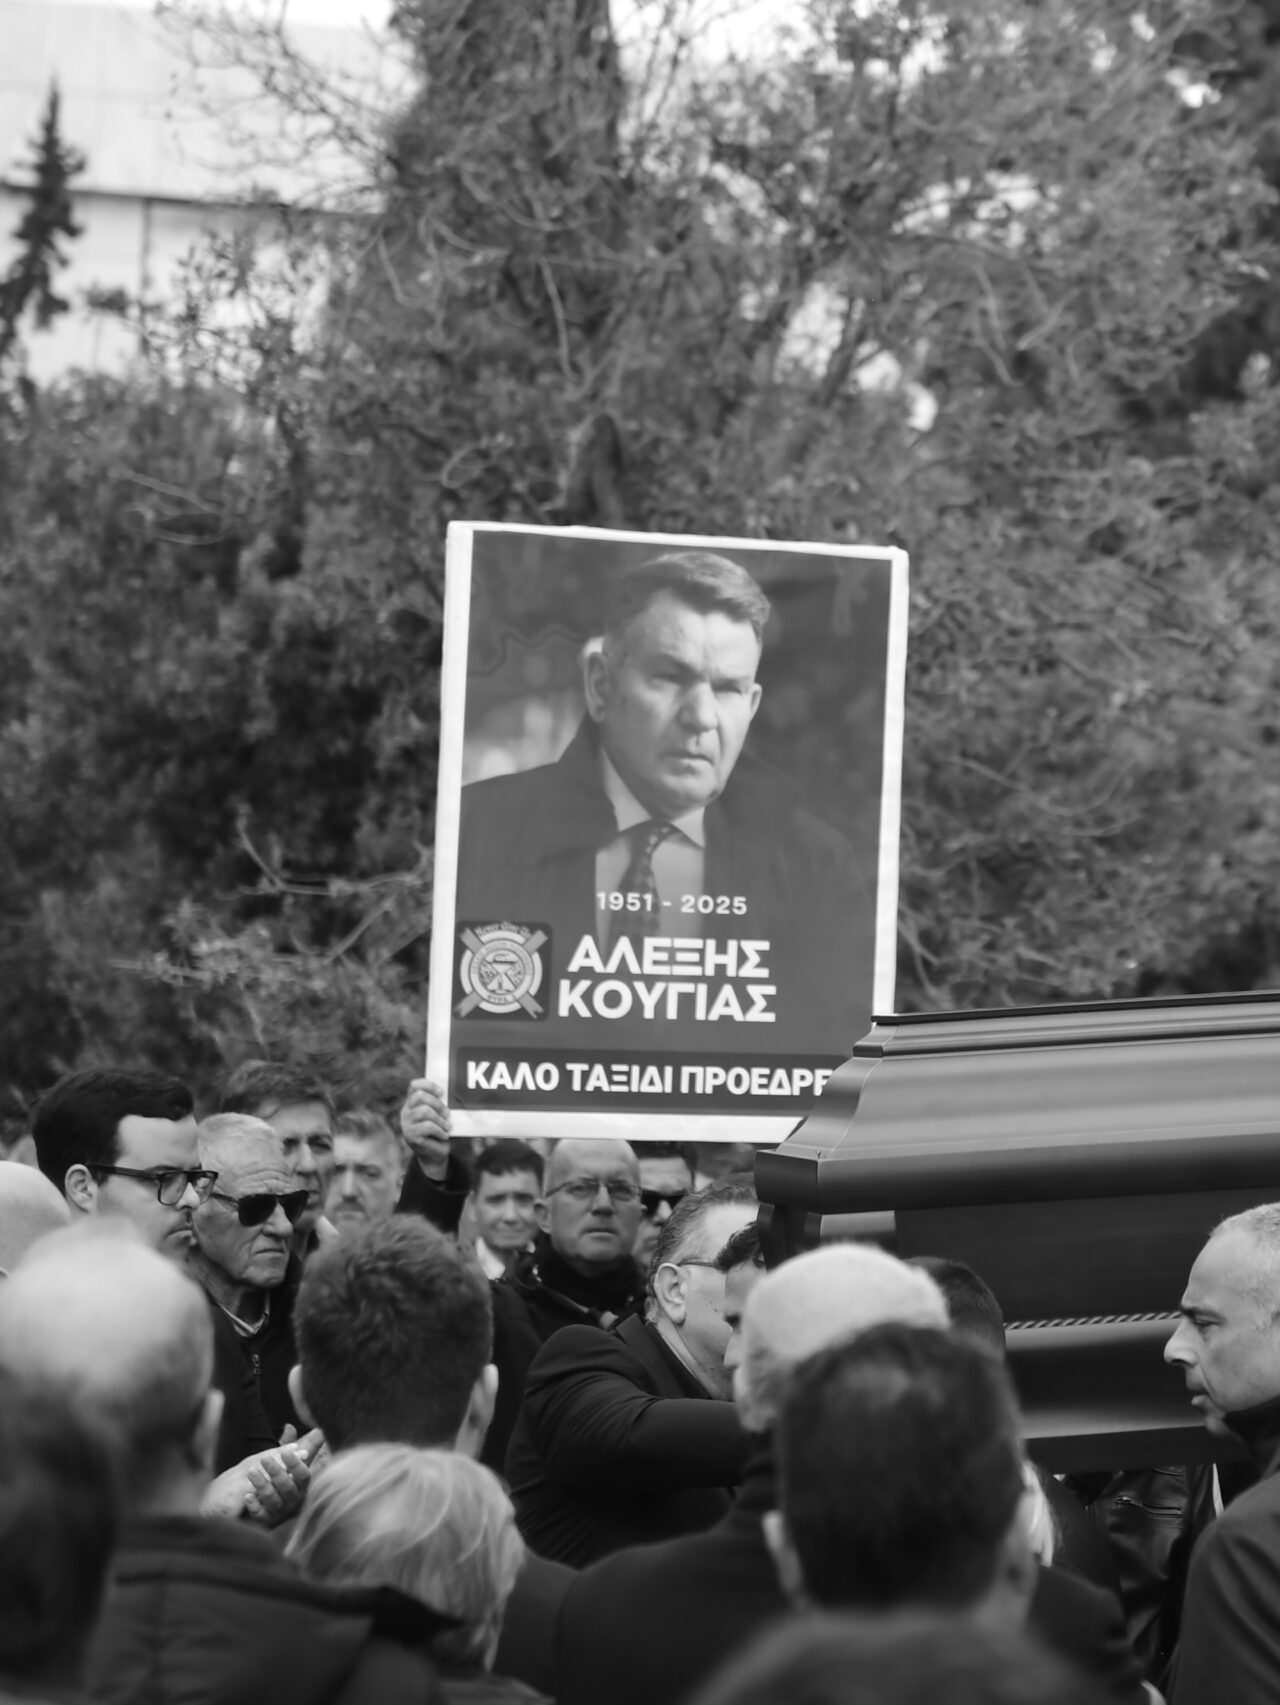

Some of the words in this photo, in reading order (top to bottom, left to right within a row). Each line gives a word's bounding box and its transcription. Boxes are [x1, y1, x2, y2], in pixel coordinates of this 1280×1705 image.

[596, 892, 653, 912] 1951
[680, 894, 748, 915] 2025
[566, 934, 771, 979] ΑΛΕΞΗΣ
[558, 978, 777, 1023] ΚΟΥΓΙΑΣ
[466, 1060, 560, 1091] ΚΑΛΟ
[565, 1063, 673, 1094] ΤΑΞΙΔΙ
